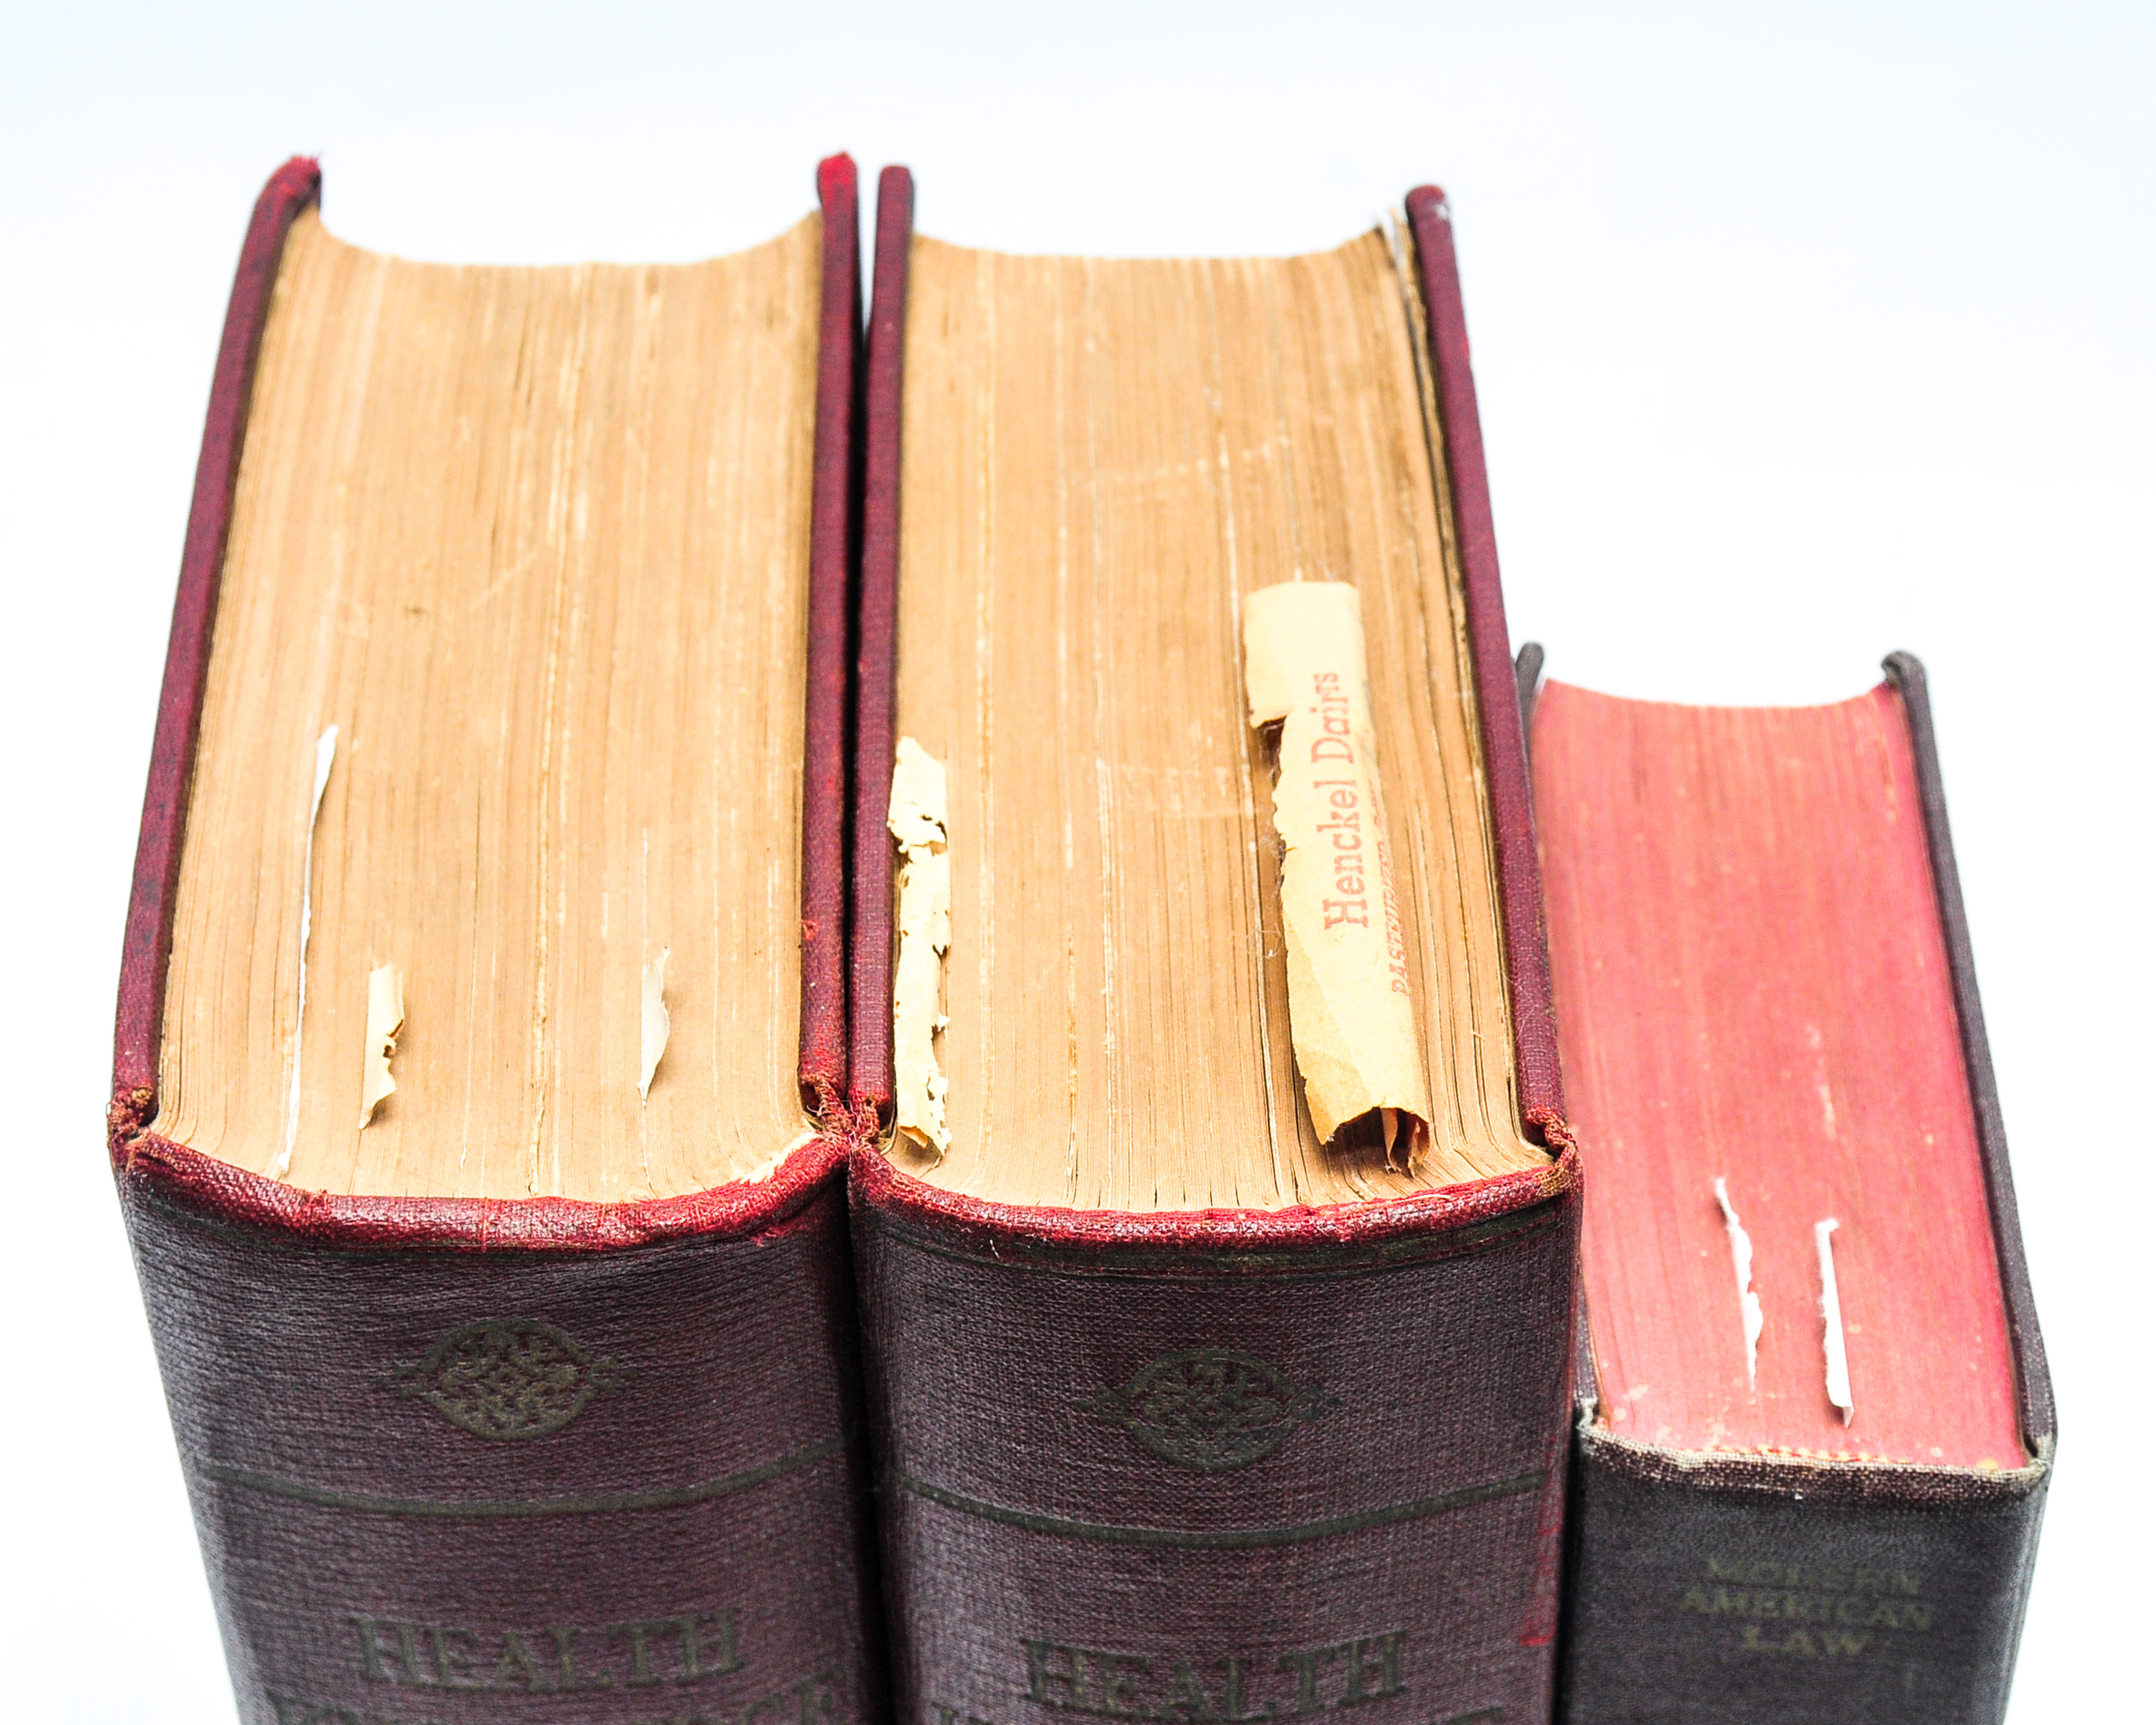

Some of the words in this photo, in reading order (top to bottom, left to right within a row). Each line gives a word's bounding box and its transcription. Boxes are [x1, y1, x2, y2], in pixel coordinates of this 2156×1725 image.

[1313, 779, 1368, 930] Henckel
[349, 1606, 745, 1693] HEALTH
[1677, 1586, 1935, 1632] AMERICAN
[1740, 1624, 1873, 1655] LAW
[1021, 1629, 1406, 1724] HEALTH
